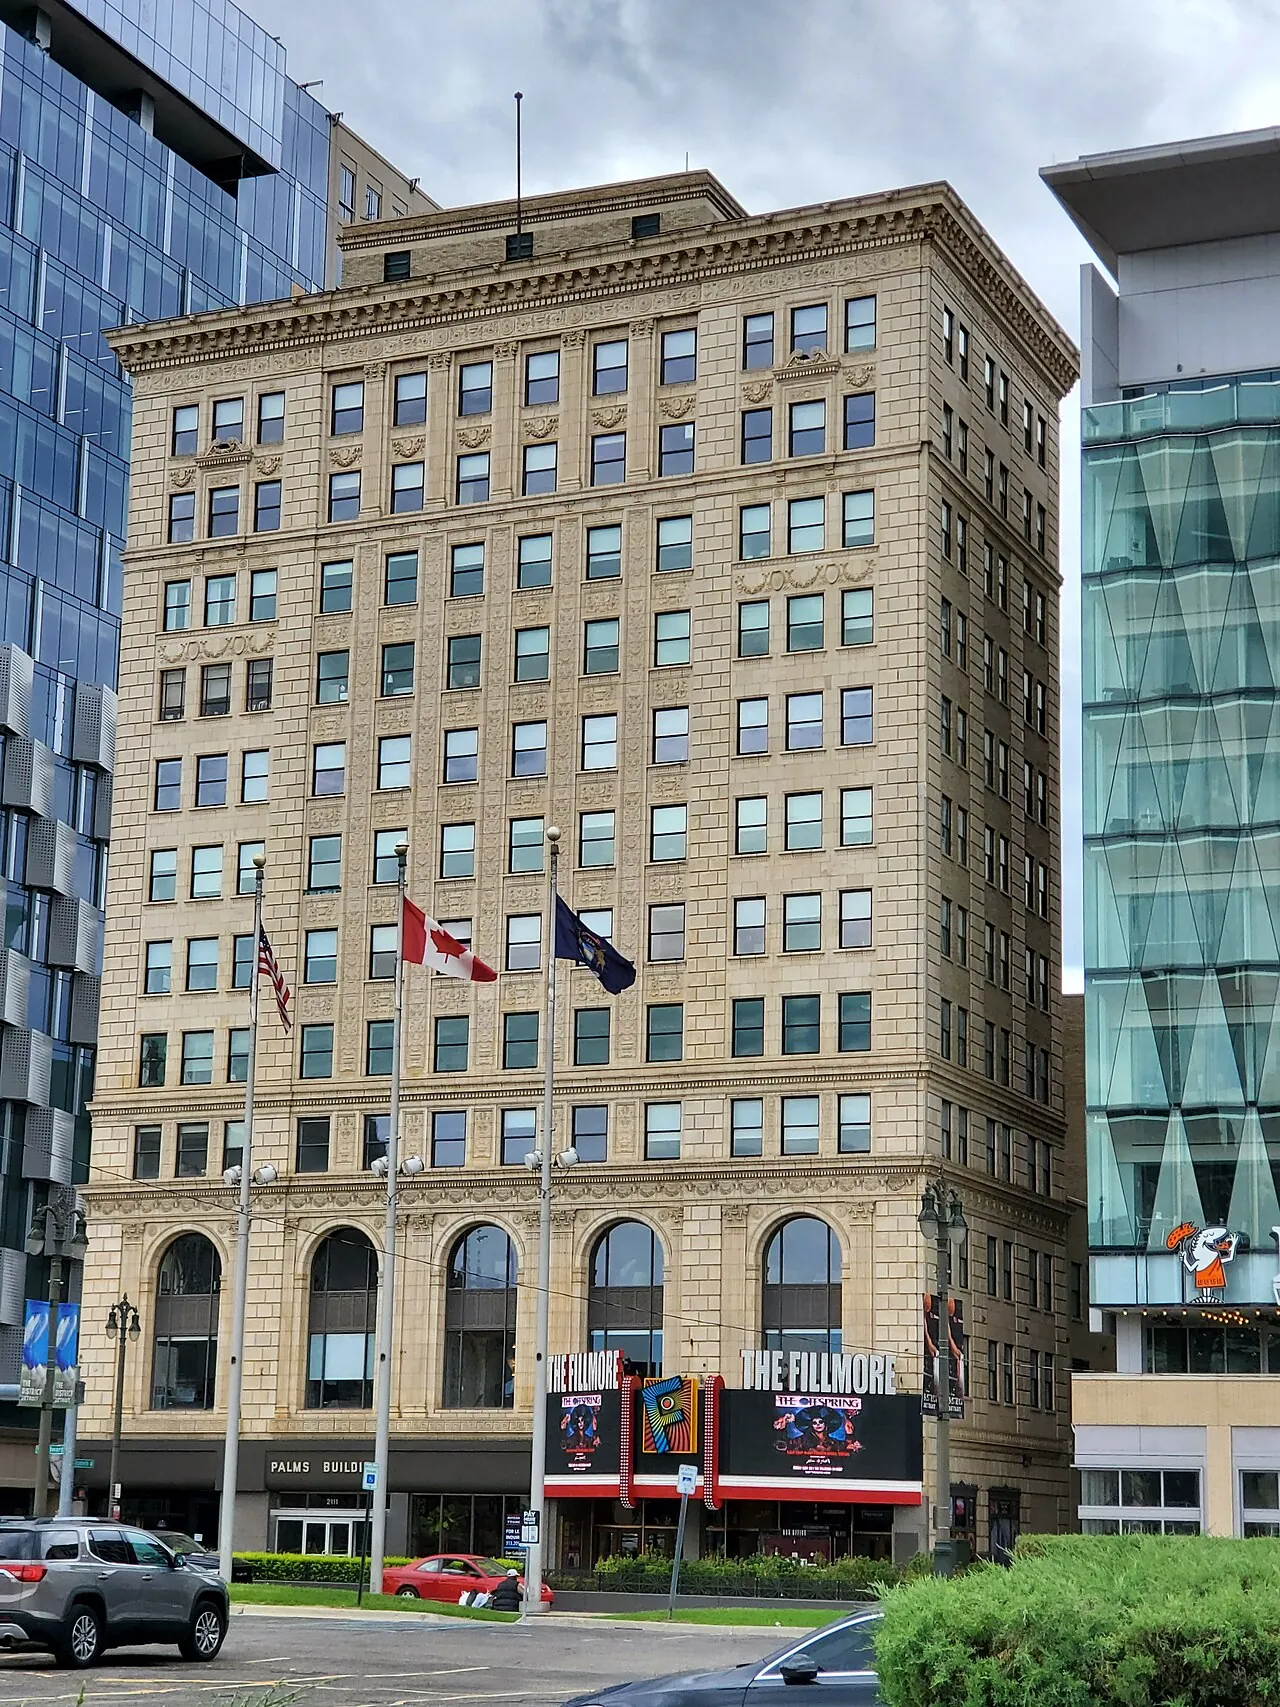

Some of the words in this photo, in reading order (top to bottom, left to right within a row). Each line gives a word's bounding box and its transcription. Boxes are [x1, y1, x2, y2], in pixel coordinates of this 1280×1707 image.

[547, 1354, 567, 1393] THE
[569, 1350, 619, 1392] FILLMORE
[740, 1349, 783, 1391] THE
[789, 1351, 897, 1395] FILLMORE
[22, 1379, 31, 1387] THE
[21, 1387, 43, 1396] DISTRICT
[563, 1397, 571, 1406] THE
[778, 1396, 796, 1406] THE
[799, 1396, 859, 1408] OFFSPRING
[271, 1461, 310, 1473] PALMS
[323, 1461, 363, 1473] BUILDI
